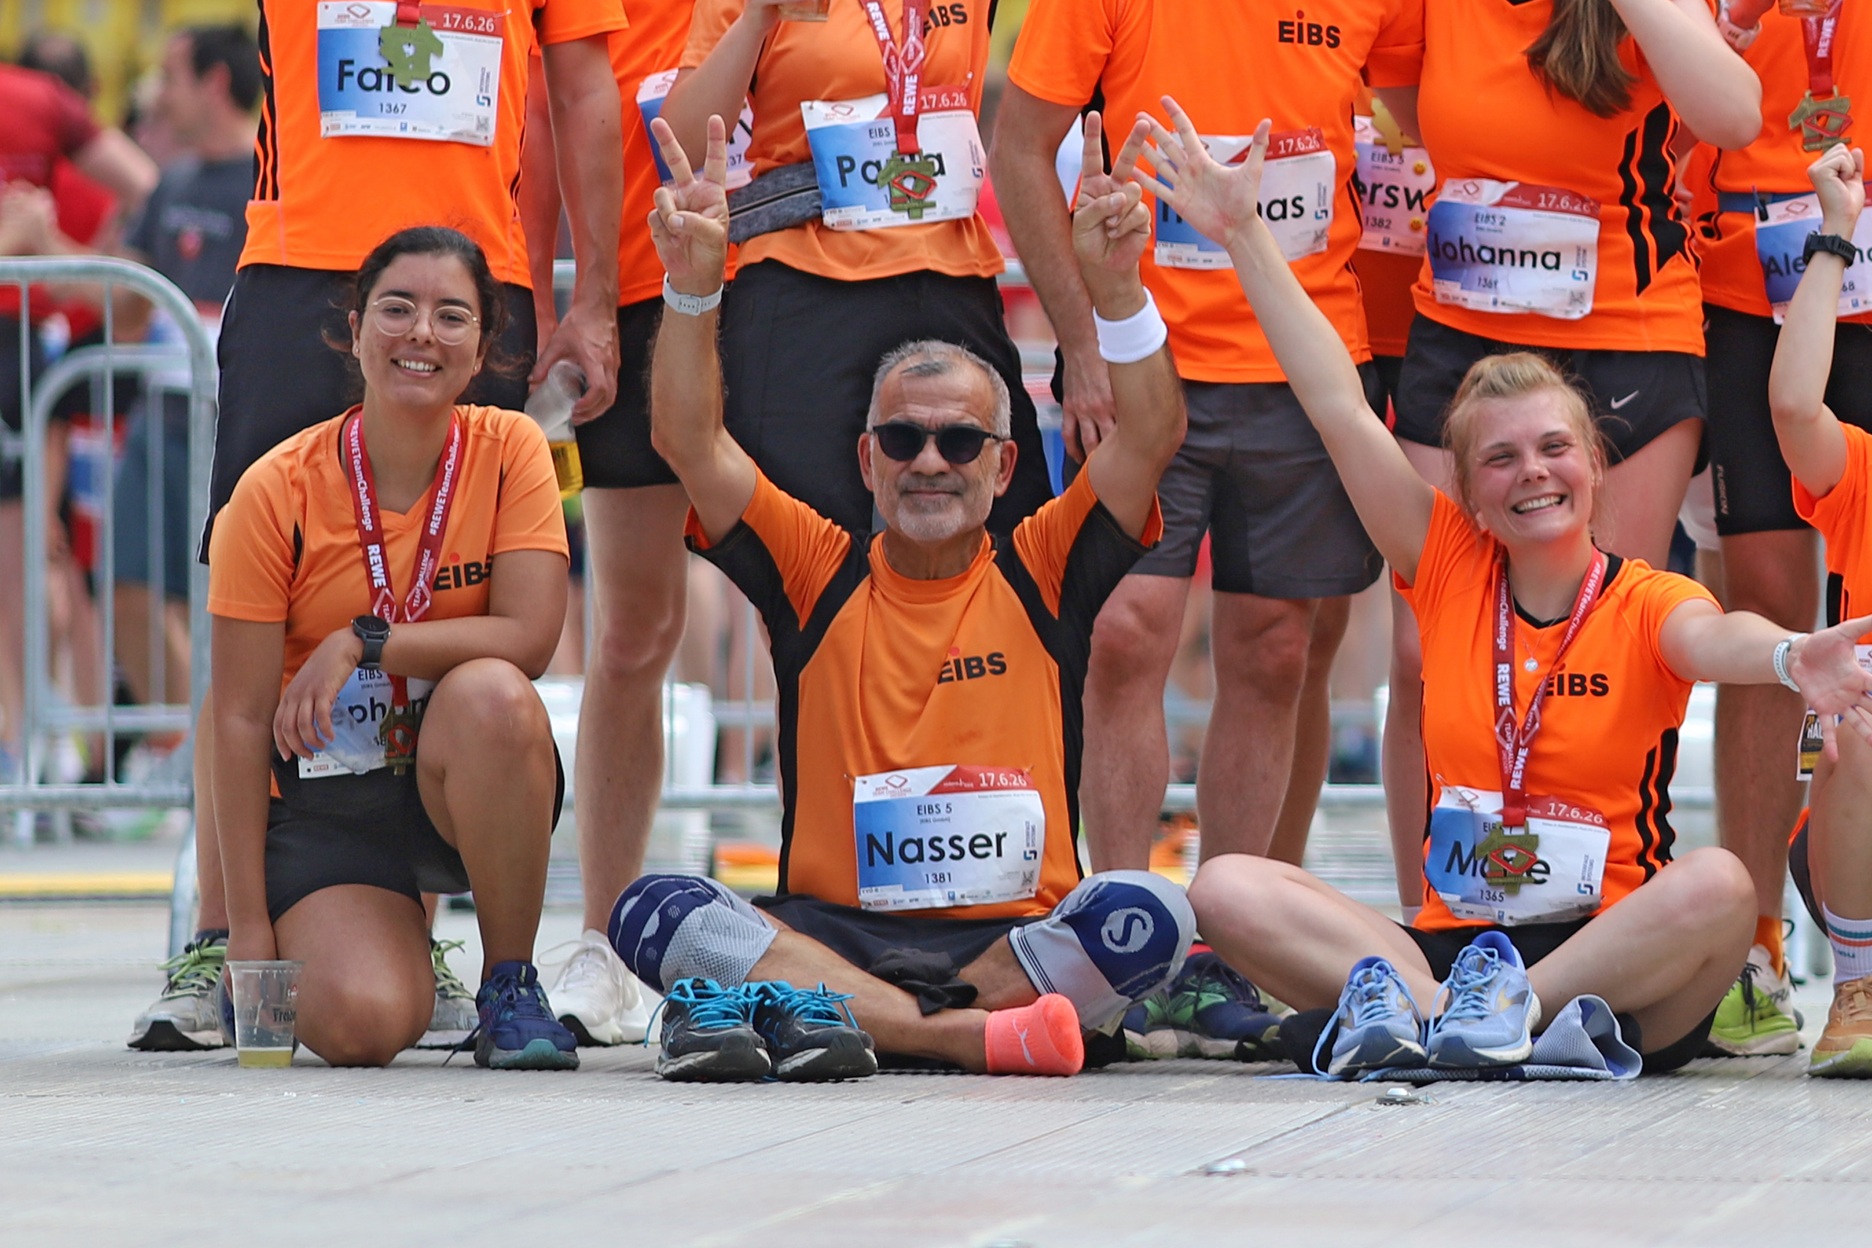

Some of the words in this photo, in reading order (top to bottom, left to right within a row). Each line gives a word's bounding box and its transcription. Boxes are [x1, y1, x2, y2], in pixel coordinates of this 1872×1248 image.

[443, 12, 495, 33] 17.6.26
[867, 1, 890, 41] REWE
[1816, 16, 1836, 58] REWE
[902, 74, 918, 115] REWE
[920, 92, 968, 110] 17.6.26
[379, 102, 407, 115] 1367
[868, 127, 891, 139] EIBS
[1278, 134, 1322, 155] 17.6.26
[836, 152, 946, 189] Paa
[1538, 192, 1591, 214] 17.6.26
[1365, 216, 1392, 229] 1382
[1430, 233, 1561, 271] Johanna
[1840, 281, 1856, 293] 68
[367, 543, 387, 589] REWE
[358, 669, 383, 682] EIBS
[1497, 663, 1511, 707] REWE
[1510, 746, 1529, 790] REWE
[979, 772, 1027, 788] 17.6.26
[917, 804, 941, 815] EIBS
[945, 802, 953, 814] 5
[1547, 802, 1603, 824] 17.6.26
[866, 831, 1008, 867] Nasser
[925, 872, 952, 884] 1381
[1480, 889, 1505, 902] 1365
